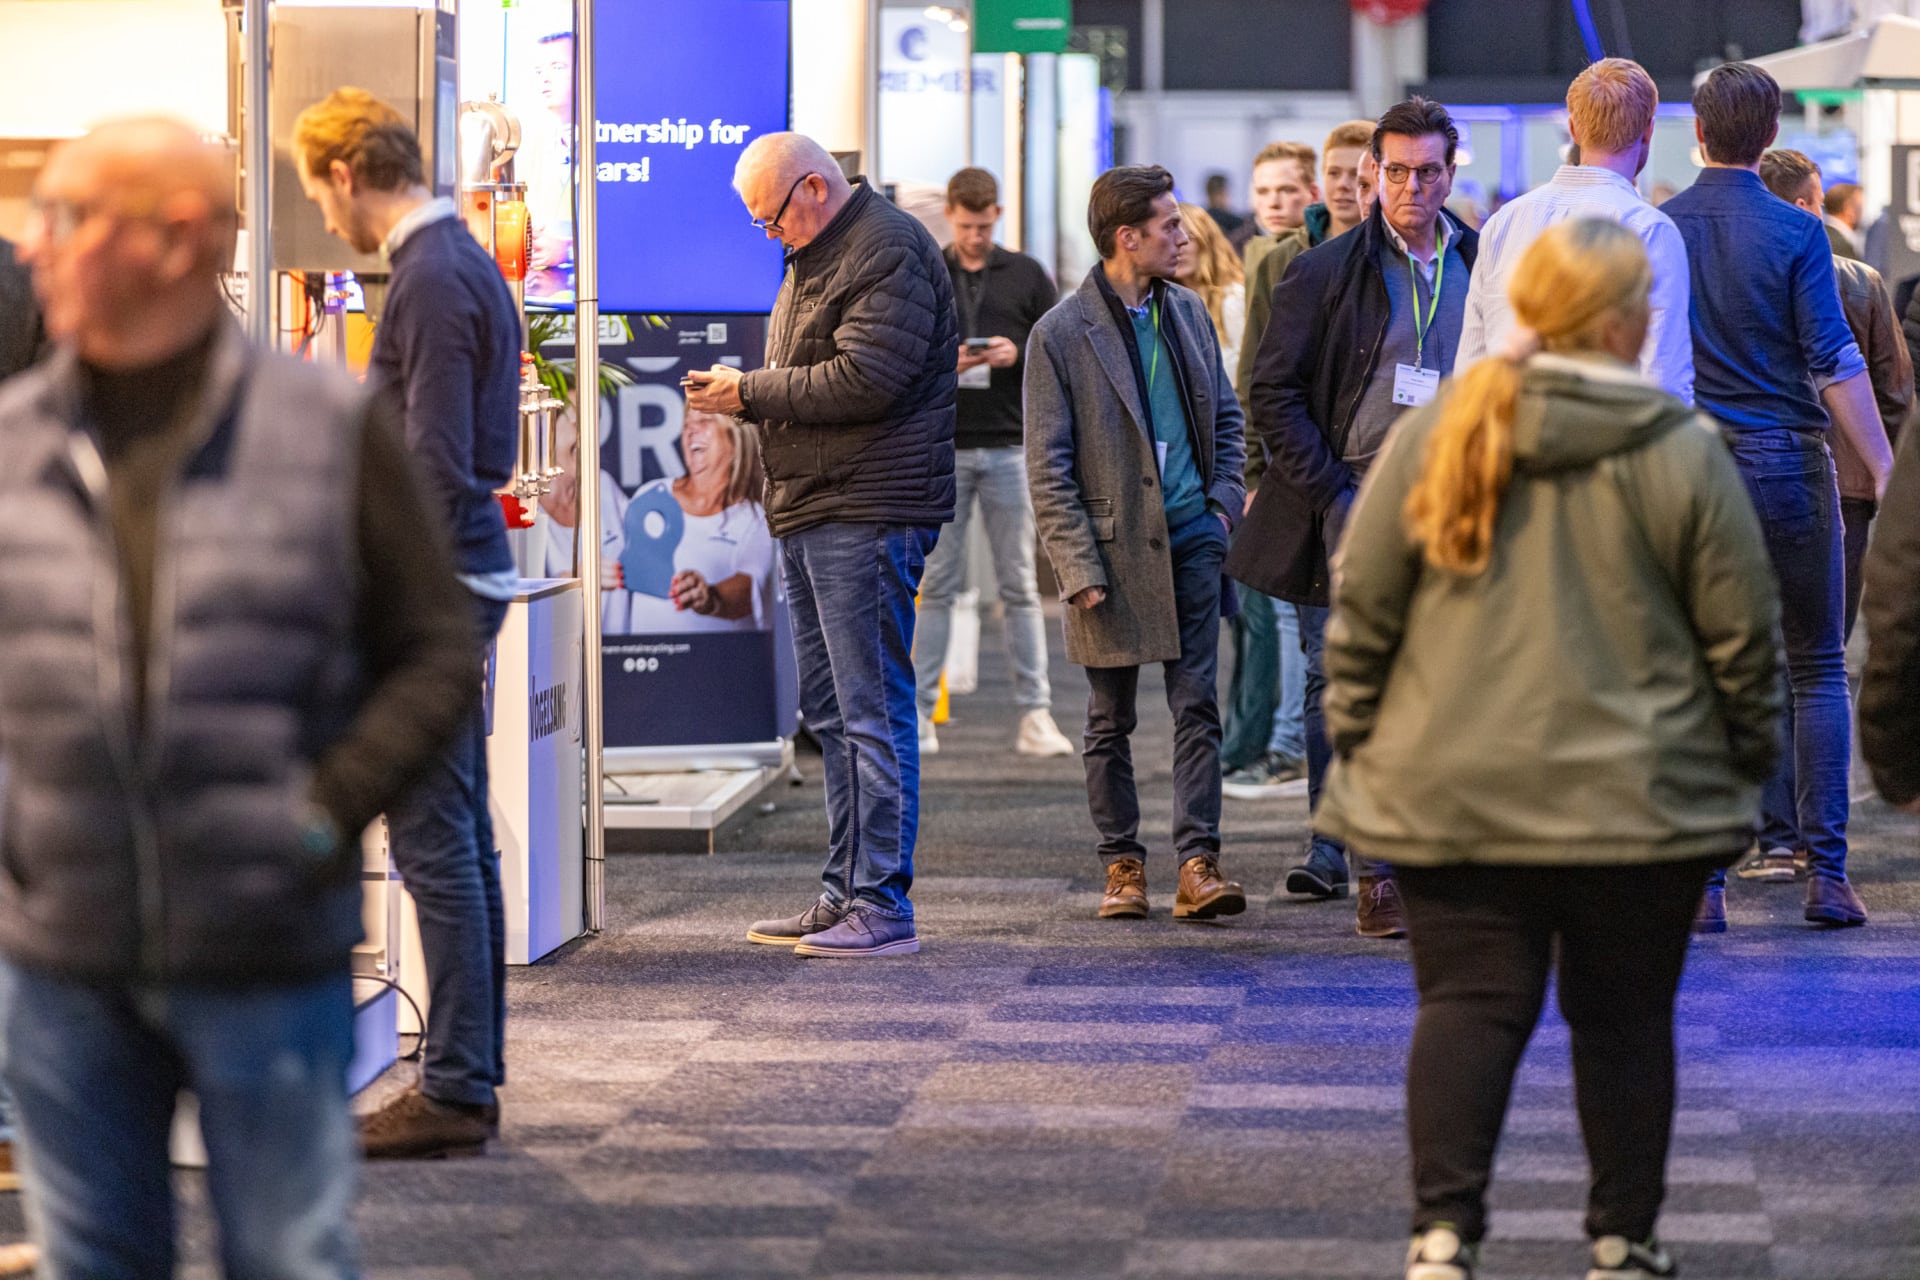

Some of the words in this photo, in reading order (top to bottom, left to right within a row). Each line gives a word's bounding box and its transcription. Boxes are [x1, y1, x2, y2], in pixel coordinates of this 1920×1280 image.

[595, 118, 704, 150] tnership
[708, 118, 751, 144] for
[596, 156, 650, 182] ars!
[529, 674, 567, 743] VOGELSANG
